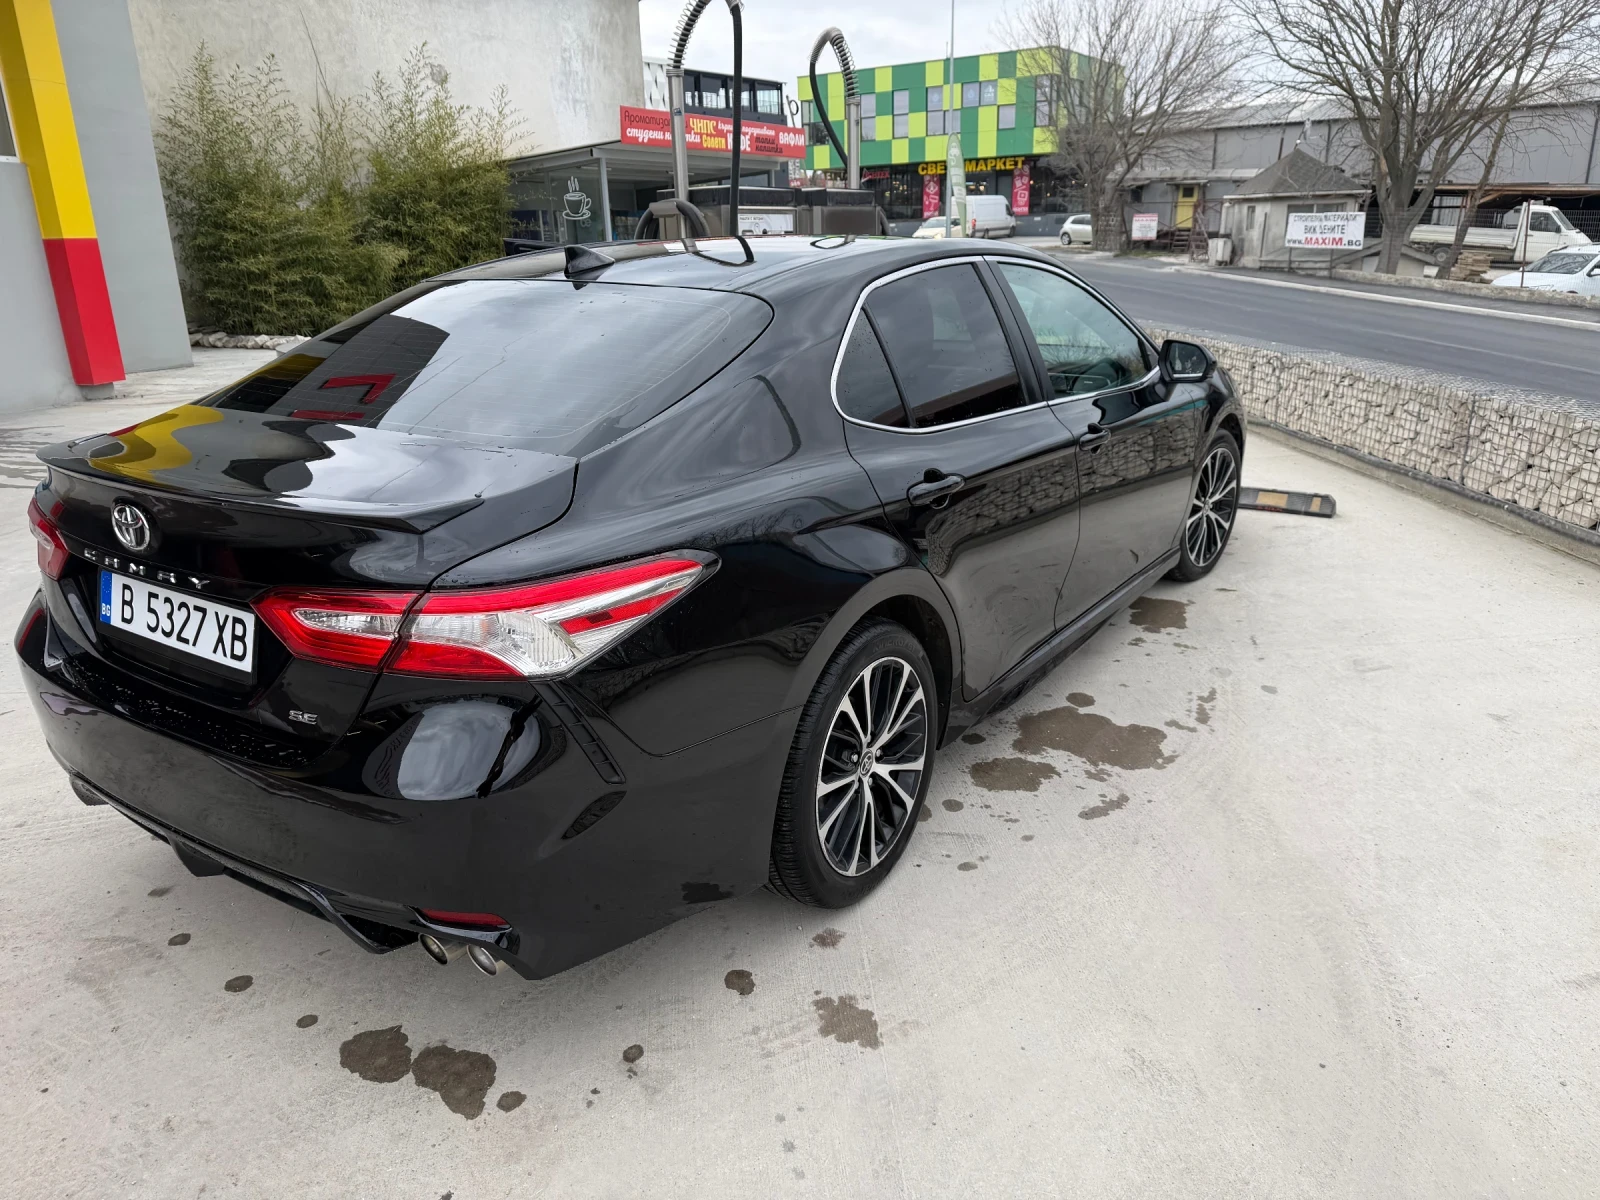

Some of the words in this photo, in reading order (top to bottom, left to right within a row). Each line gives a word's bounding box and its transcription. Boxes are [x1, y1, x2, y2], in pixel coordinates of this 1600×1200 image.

[626, 127, 664, 143] студени
[779, 132, 805, 147] ВАФЛИ
[965, 157, 1025, 172] МАРКЕТ
[84, 547, 210, 589] CAMRY
[102, 603, 111, 617] BG
[121, 583, 134, 625] B
[146, 592, 208, 647] 5327
[212, 611, 248, 662] XB
[288, 710, 318, 725] SE
